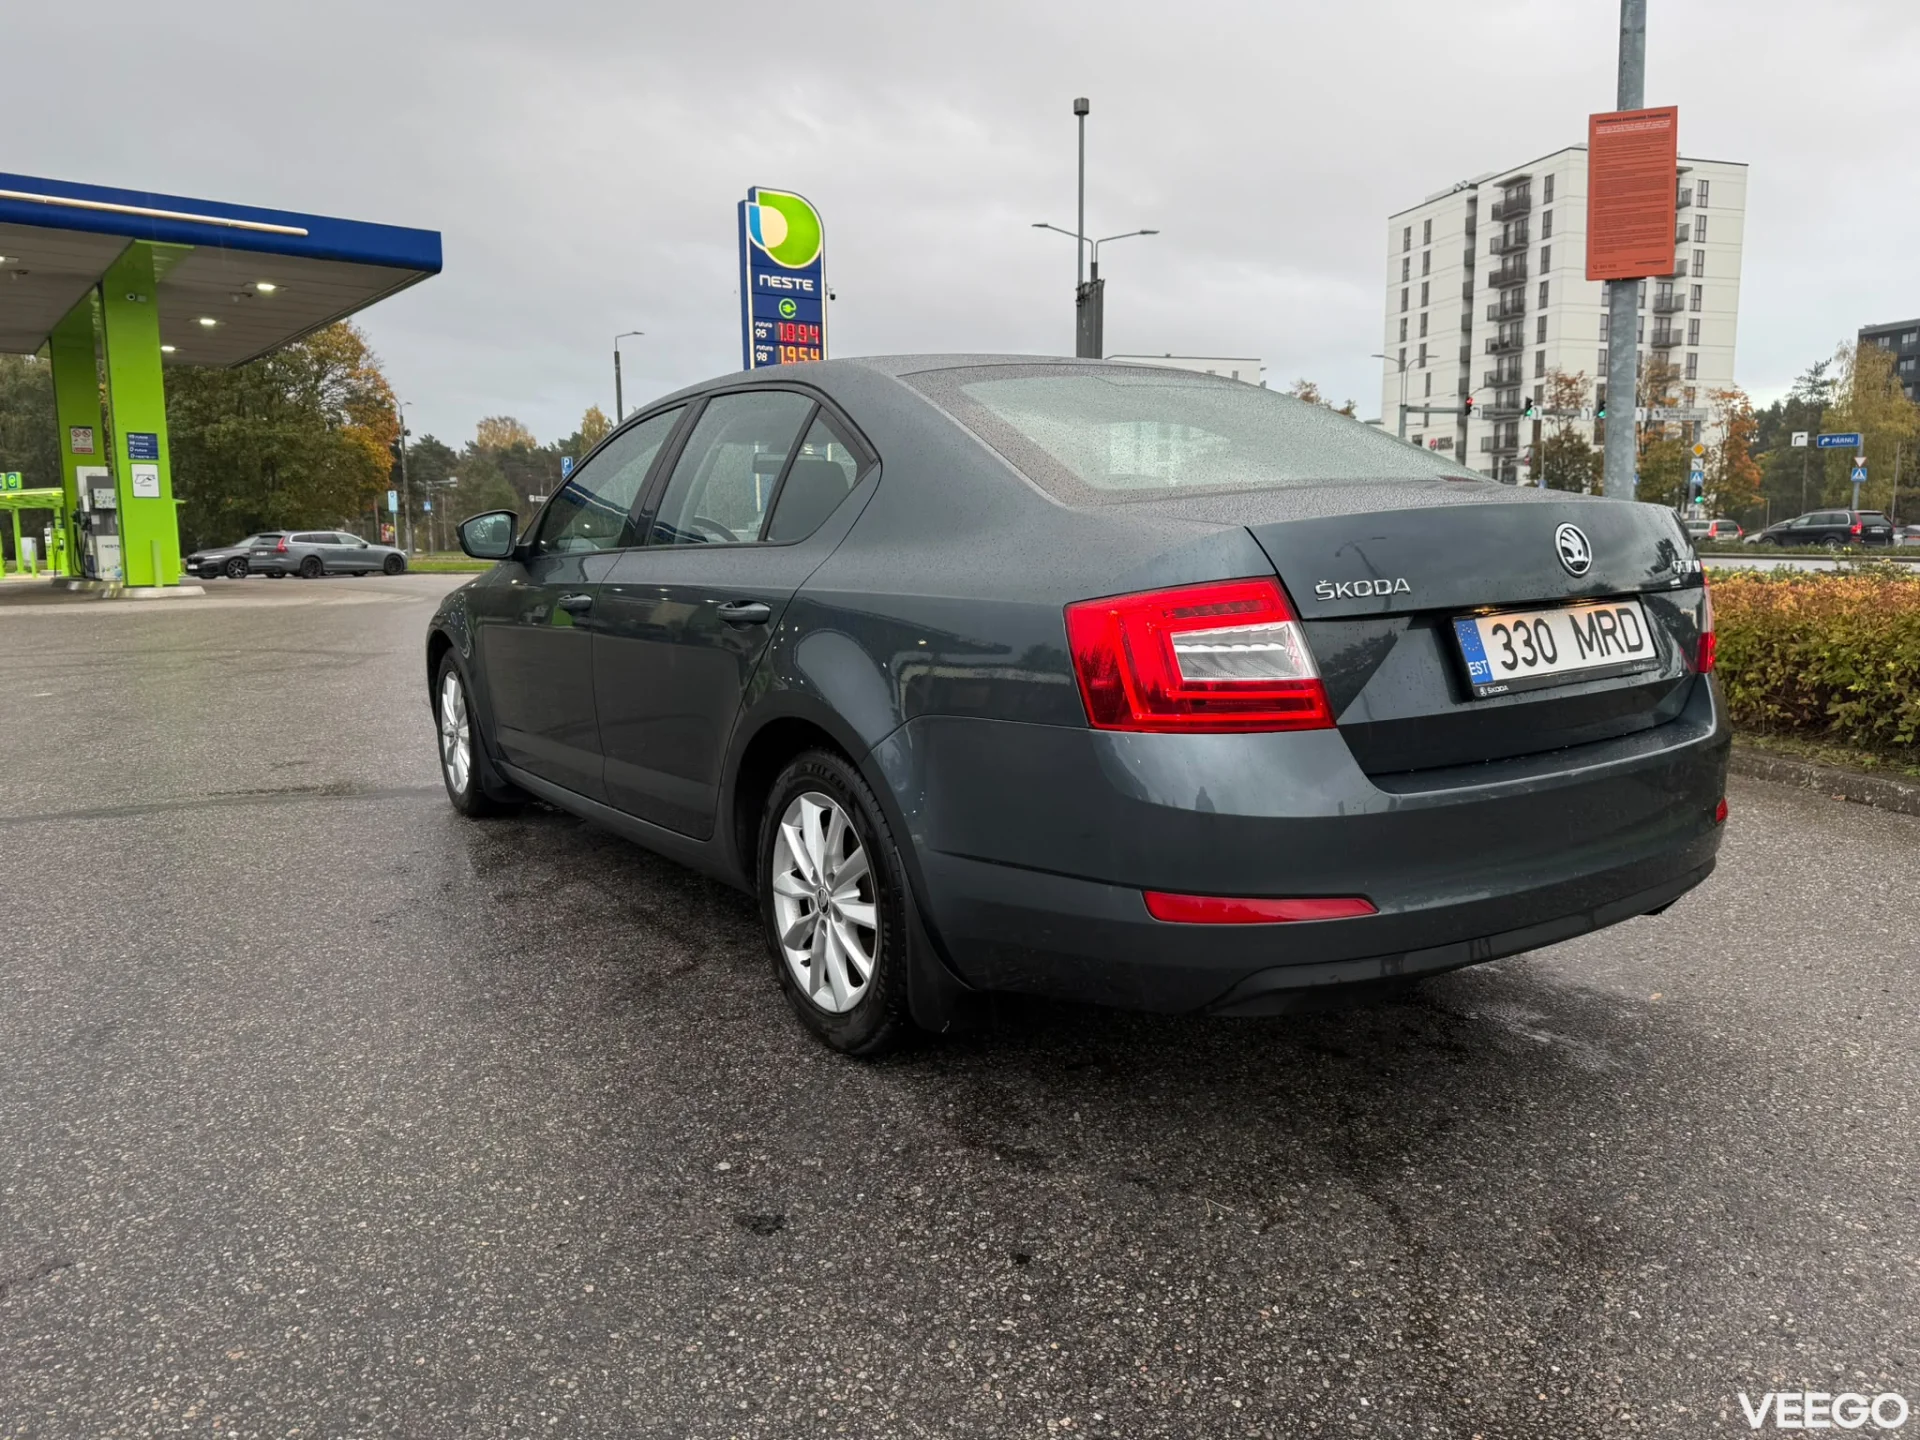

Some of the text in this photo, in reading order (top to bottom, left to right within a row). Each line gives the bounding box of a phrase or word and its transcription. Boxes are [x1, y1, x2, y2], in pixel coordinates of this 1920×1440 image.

[759, 274, 814, 291] NESTE
[755, 328, 767, 338] 95
[756, 351, 768, 361] 98
[564, 458, 570, 468] P
[1315, 578, 1412, 601] ŠKODA
[1492, 608, 1644, 671] 330 MRD
[1468, 660, 1489, 676] EST
